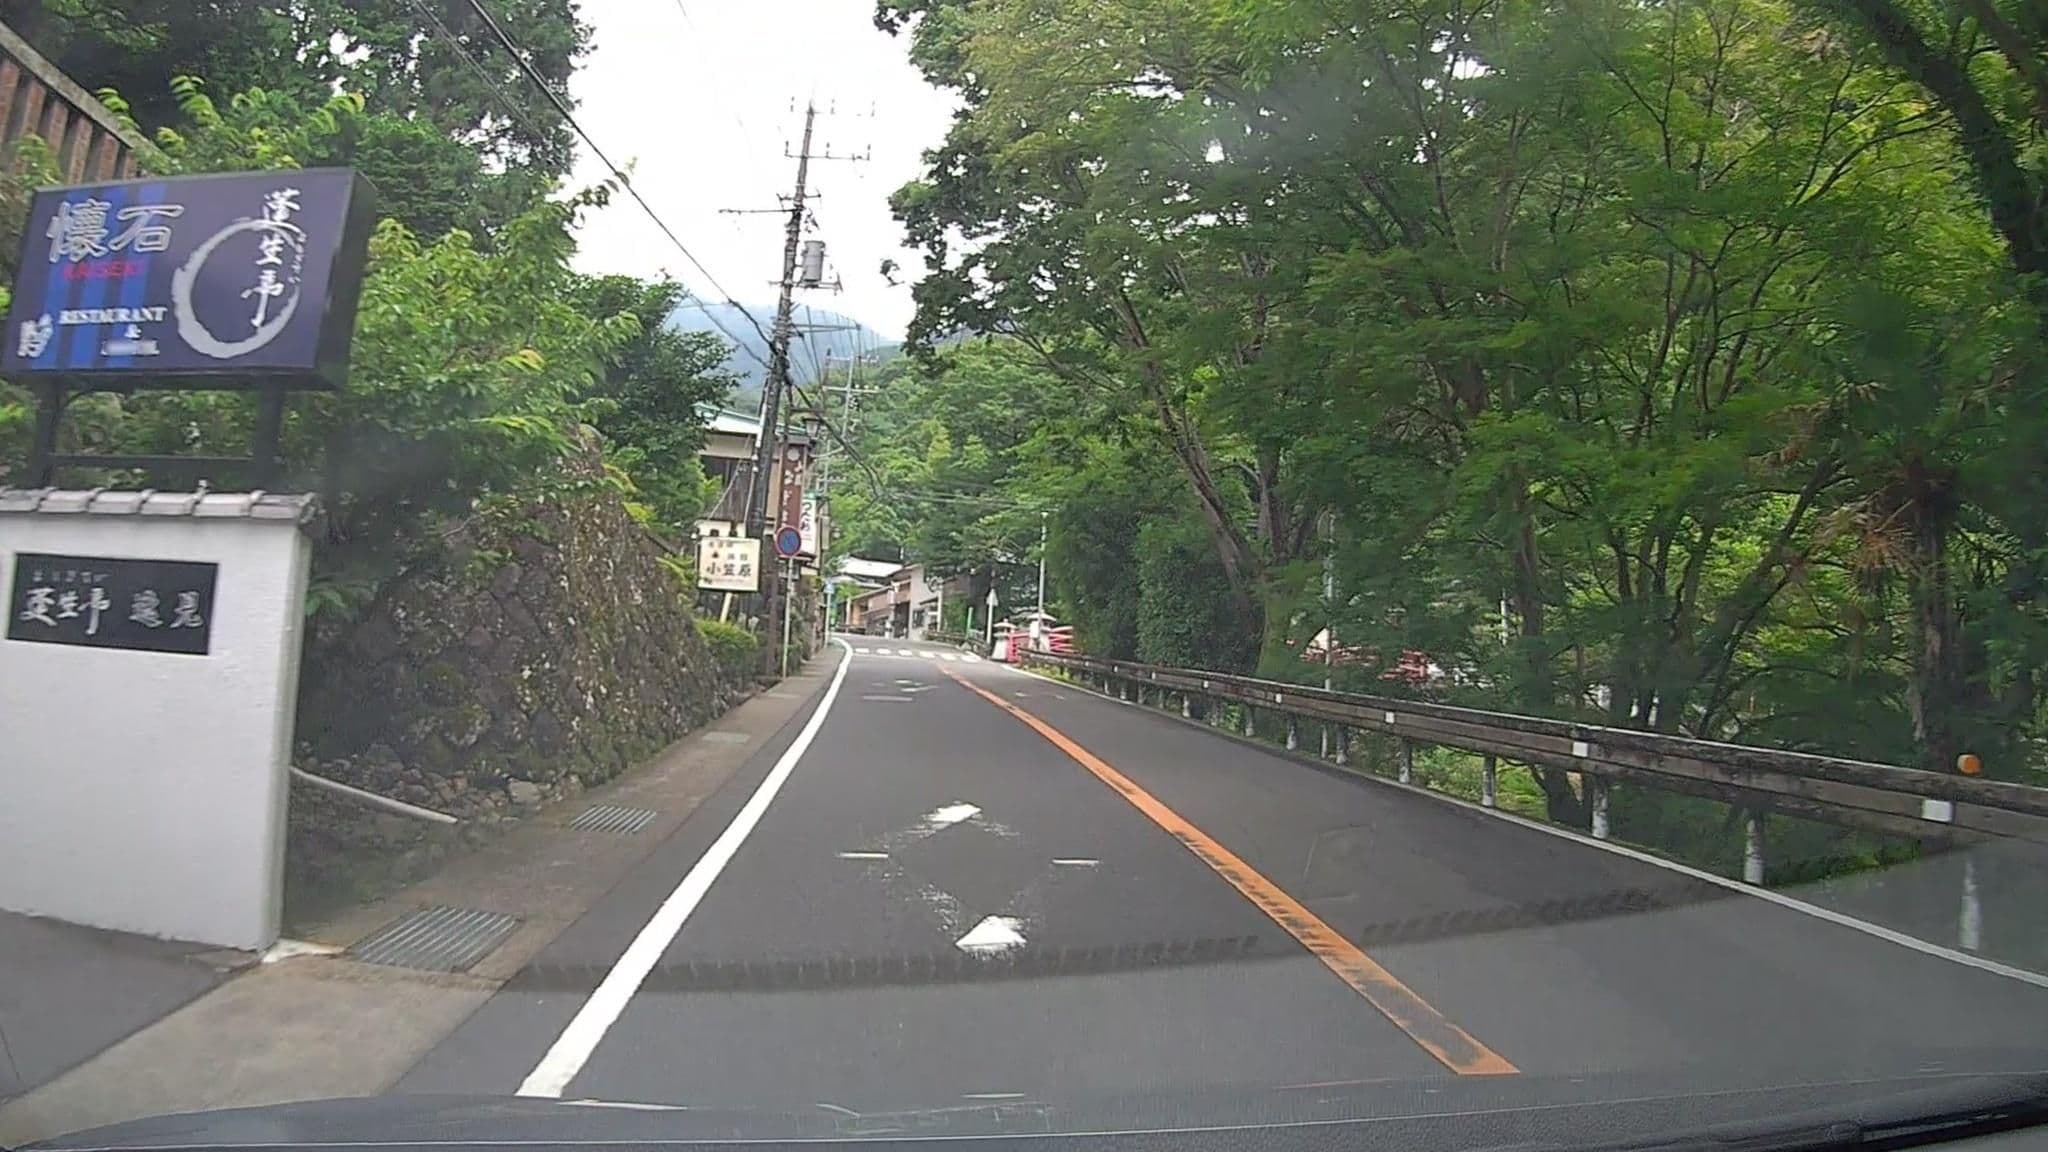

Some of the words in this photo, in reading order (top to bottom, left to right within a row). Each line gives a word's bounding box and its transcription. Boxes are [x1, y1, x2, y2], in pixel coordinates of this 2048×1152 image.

[57, 306, 168, 325] RESTAURANT
[123, 324, 142, 338] &
[706, 561, 752, 577] 小笠原
